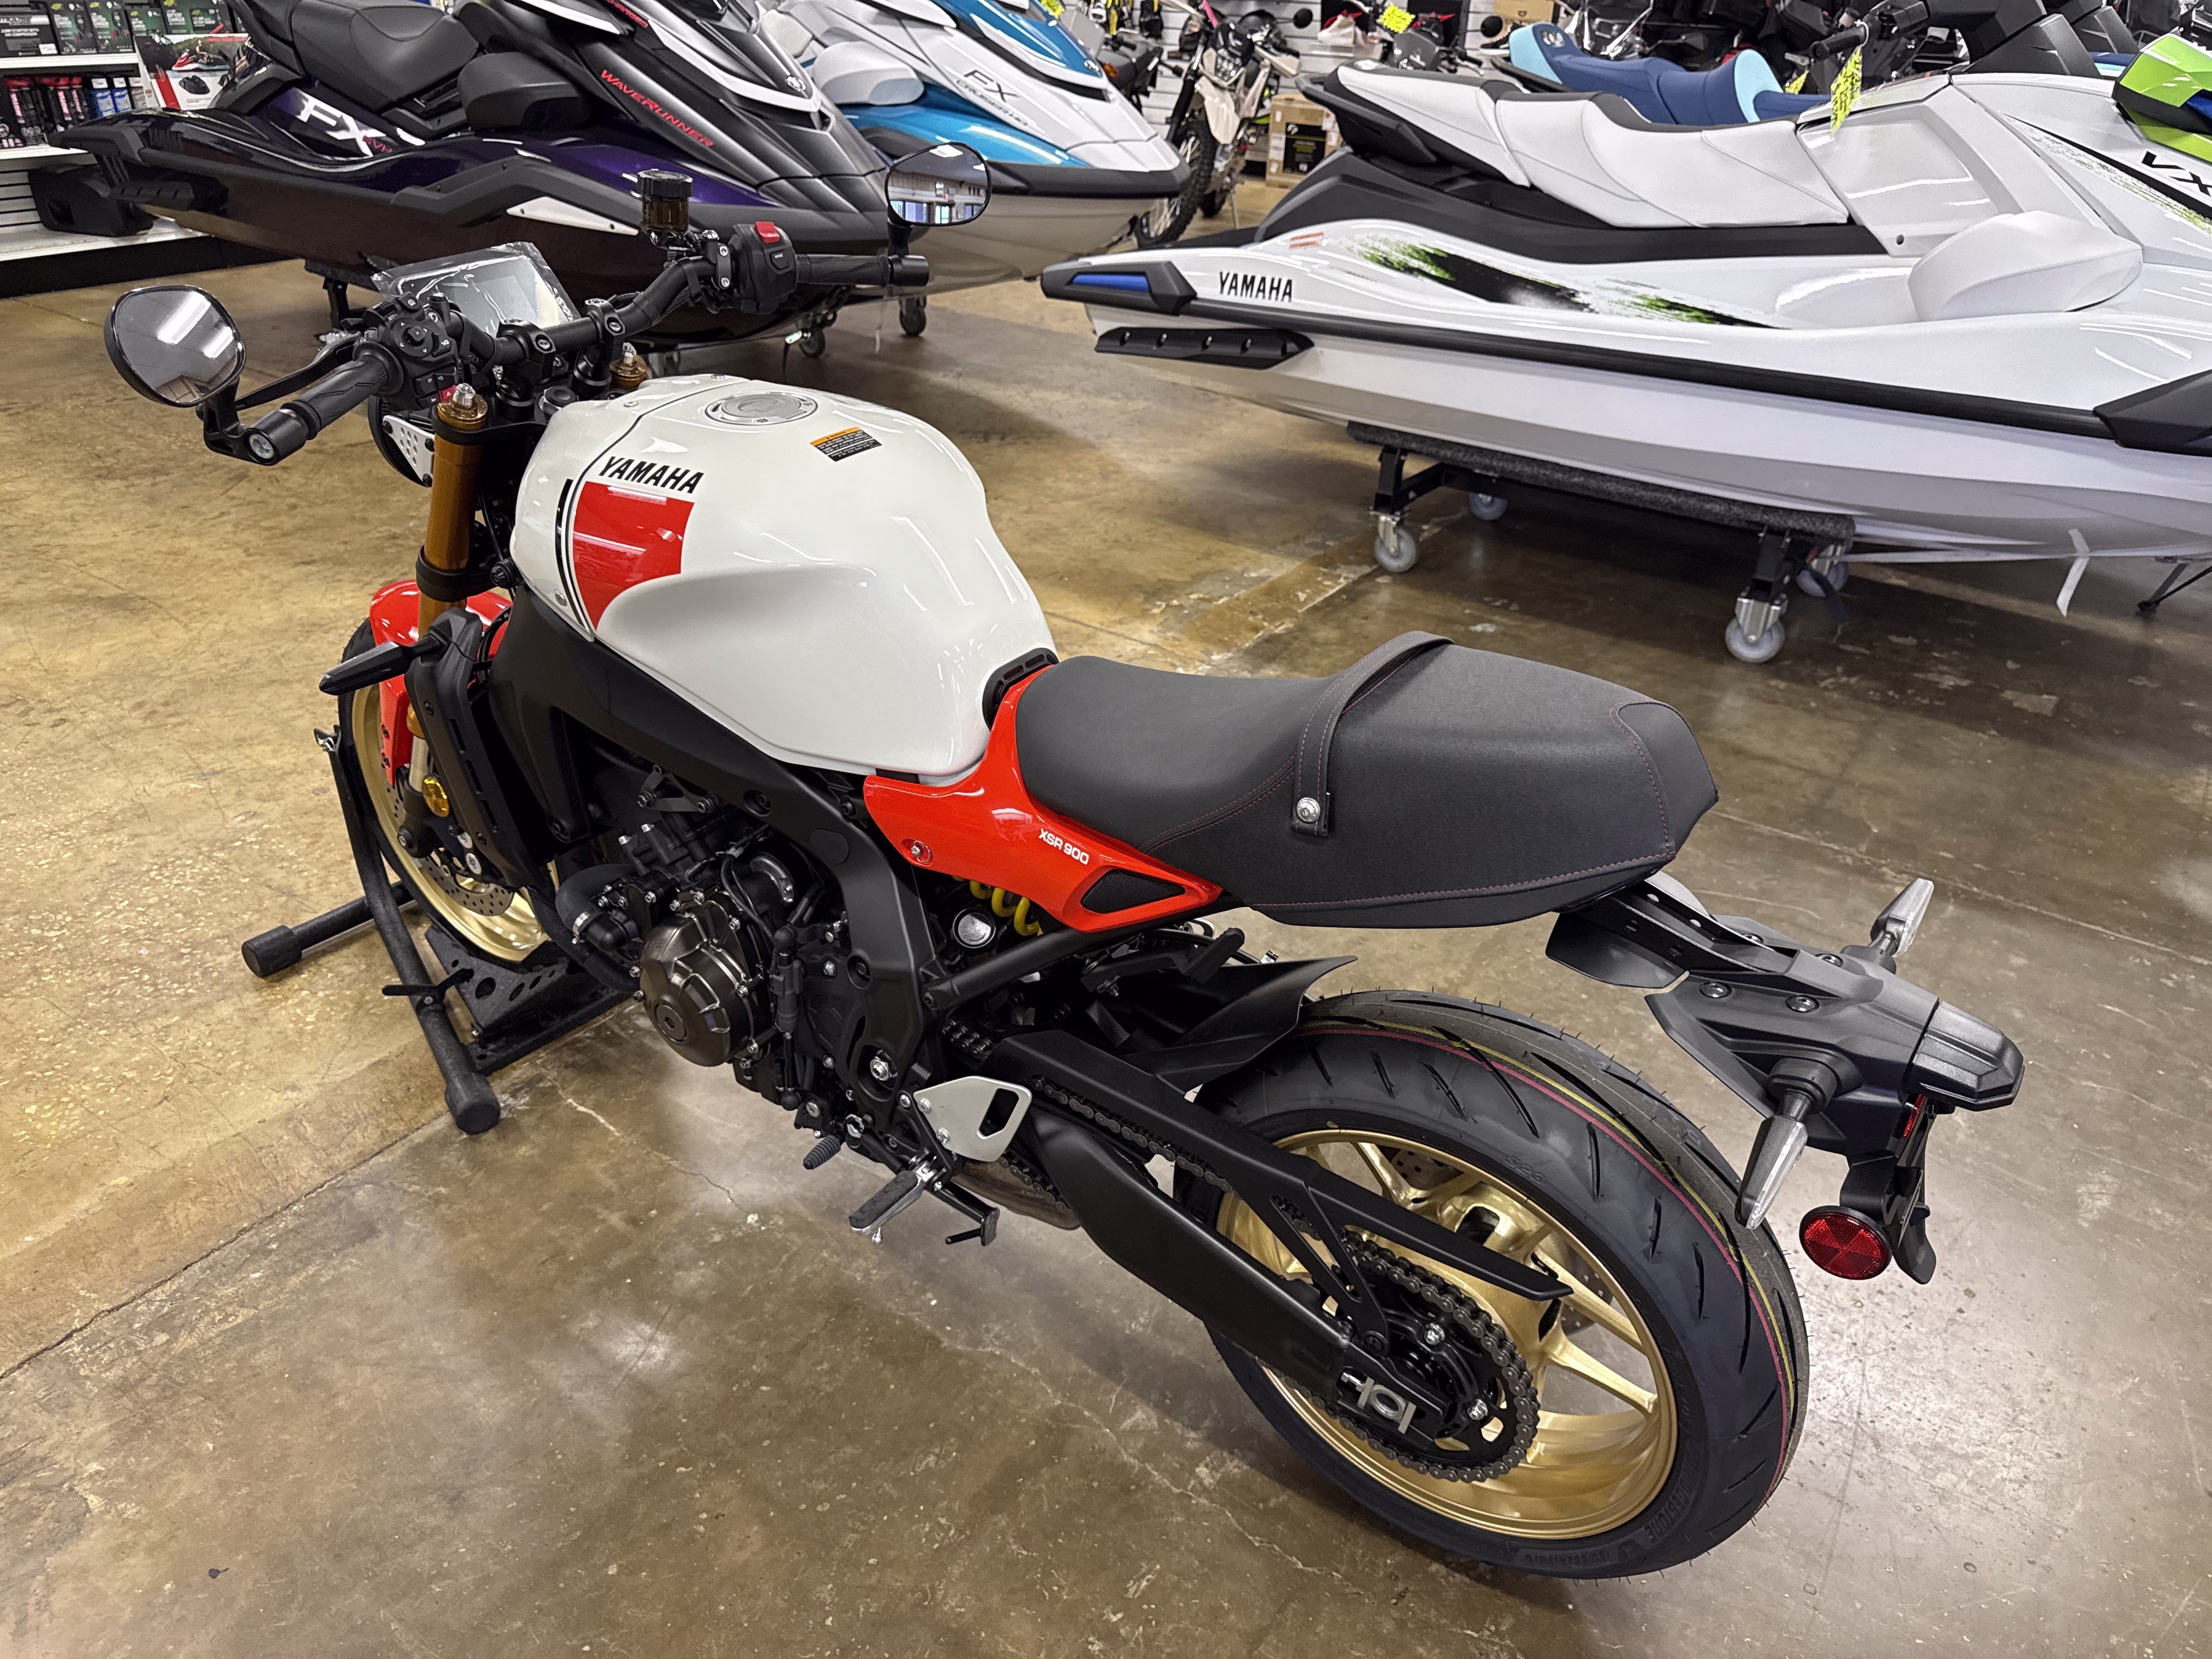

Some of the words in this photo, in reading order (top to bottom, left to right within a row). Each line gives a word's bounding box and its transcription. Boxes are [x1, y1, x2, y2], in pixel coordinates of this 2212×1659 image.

[963, 70, 1019, 103] FX
[295, 89, 387, 157] FX
[2141, 151, 2212, 197] VX
[1220, 271, 1293, 302] YAMAHA
[599, 456, 704, 494] YAMAHA
[1038, 828, 1063, 850] XSR
[1063, 842, 1090, 865] 900
